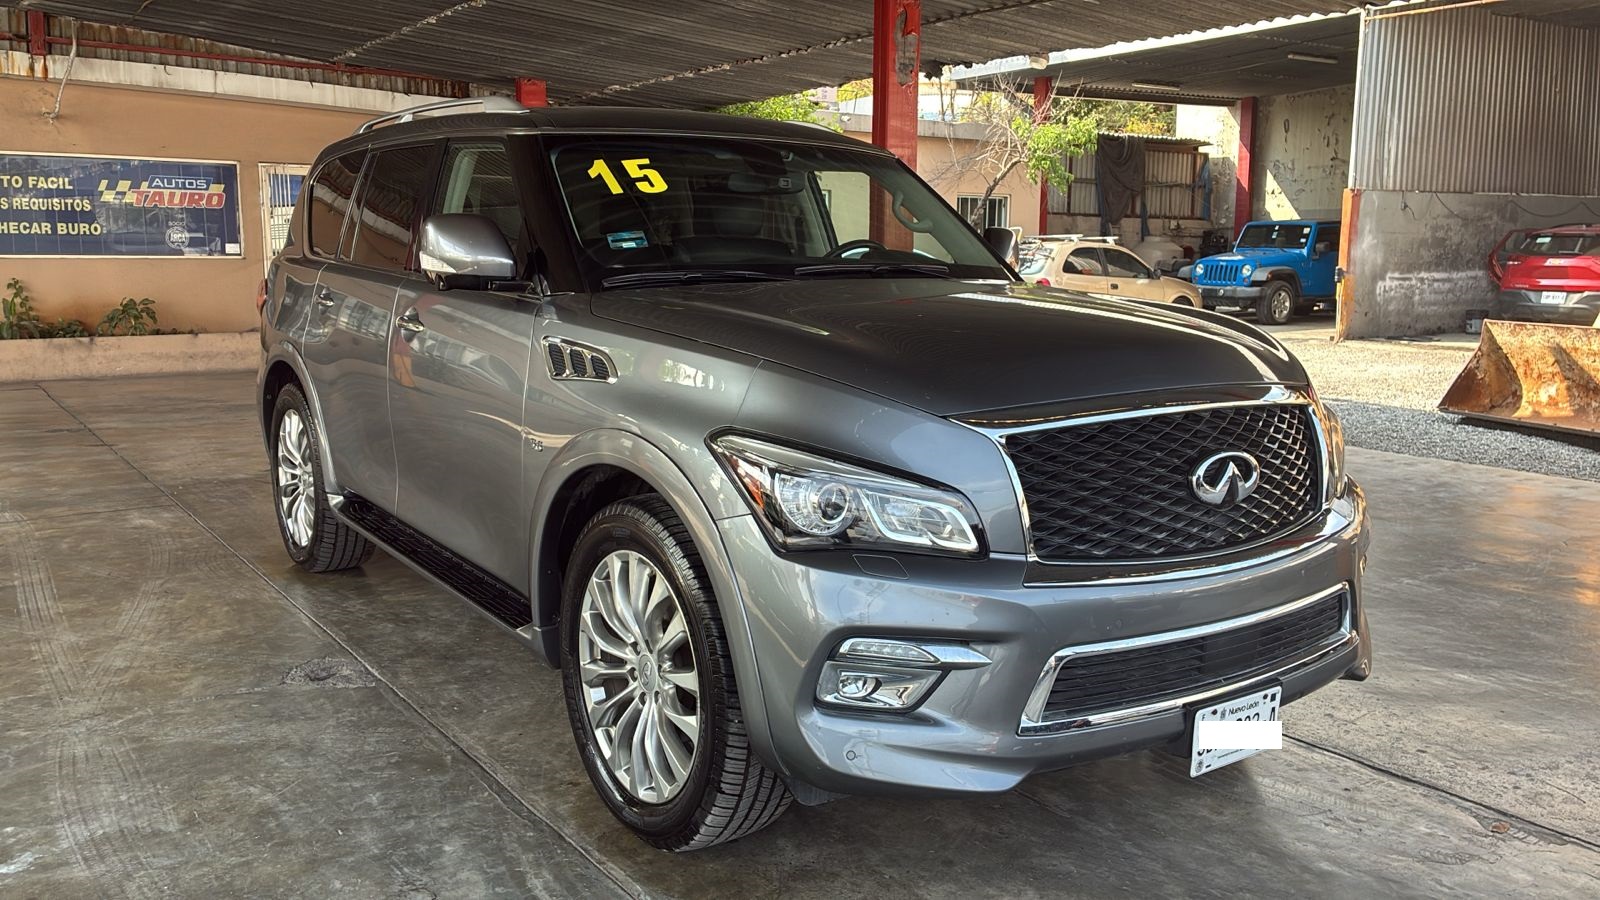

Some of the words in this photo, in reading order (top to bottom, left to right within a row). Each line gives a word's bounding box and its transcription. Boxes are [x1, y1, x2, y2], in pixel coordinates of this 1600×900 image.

[0, 175, 23, 188] TO
[27, 176, 73, 189] FACIL
[151, 177, 207, 189] AUTOS
[587, 158, 668, 195] 15
[0, 197, 9, 210] S
[12, 198, 91, 211] REQUISITOS
[130, 189, 226, 209] TAURO
[1228, 704, 1246, 715] Nuevo
